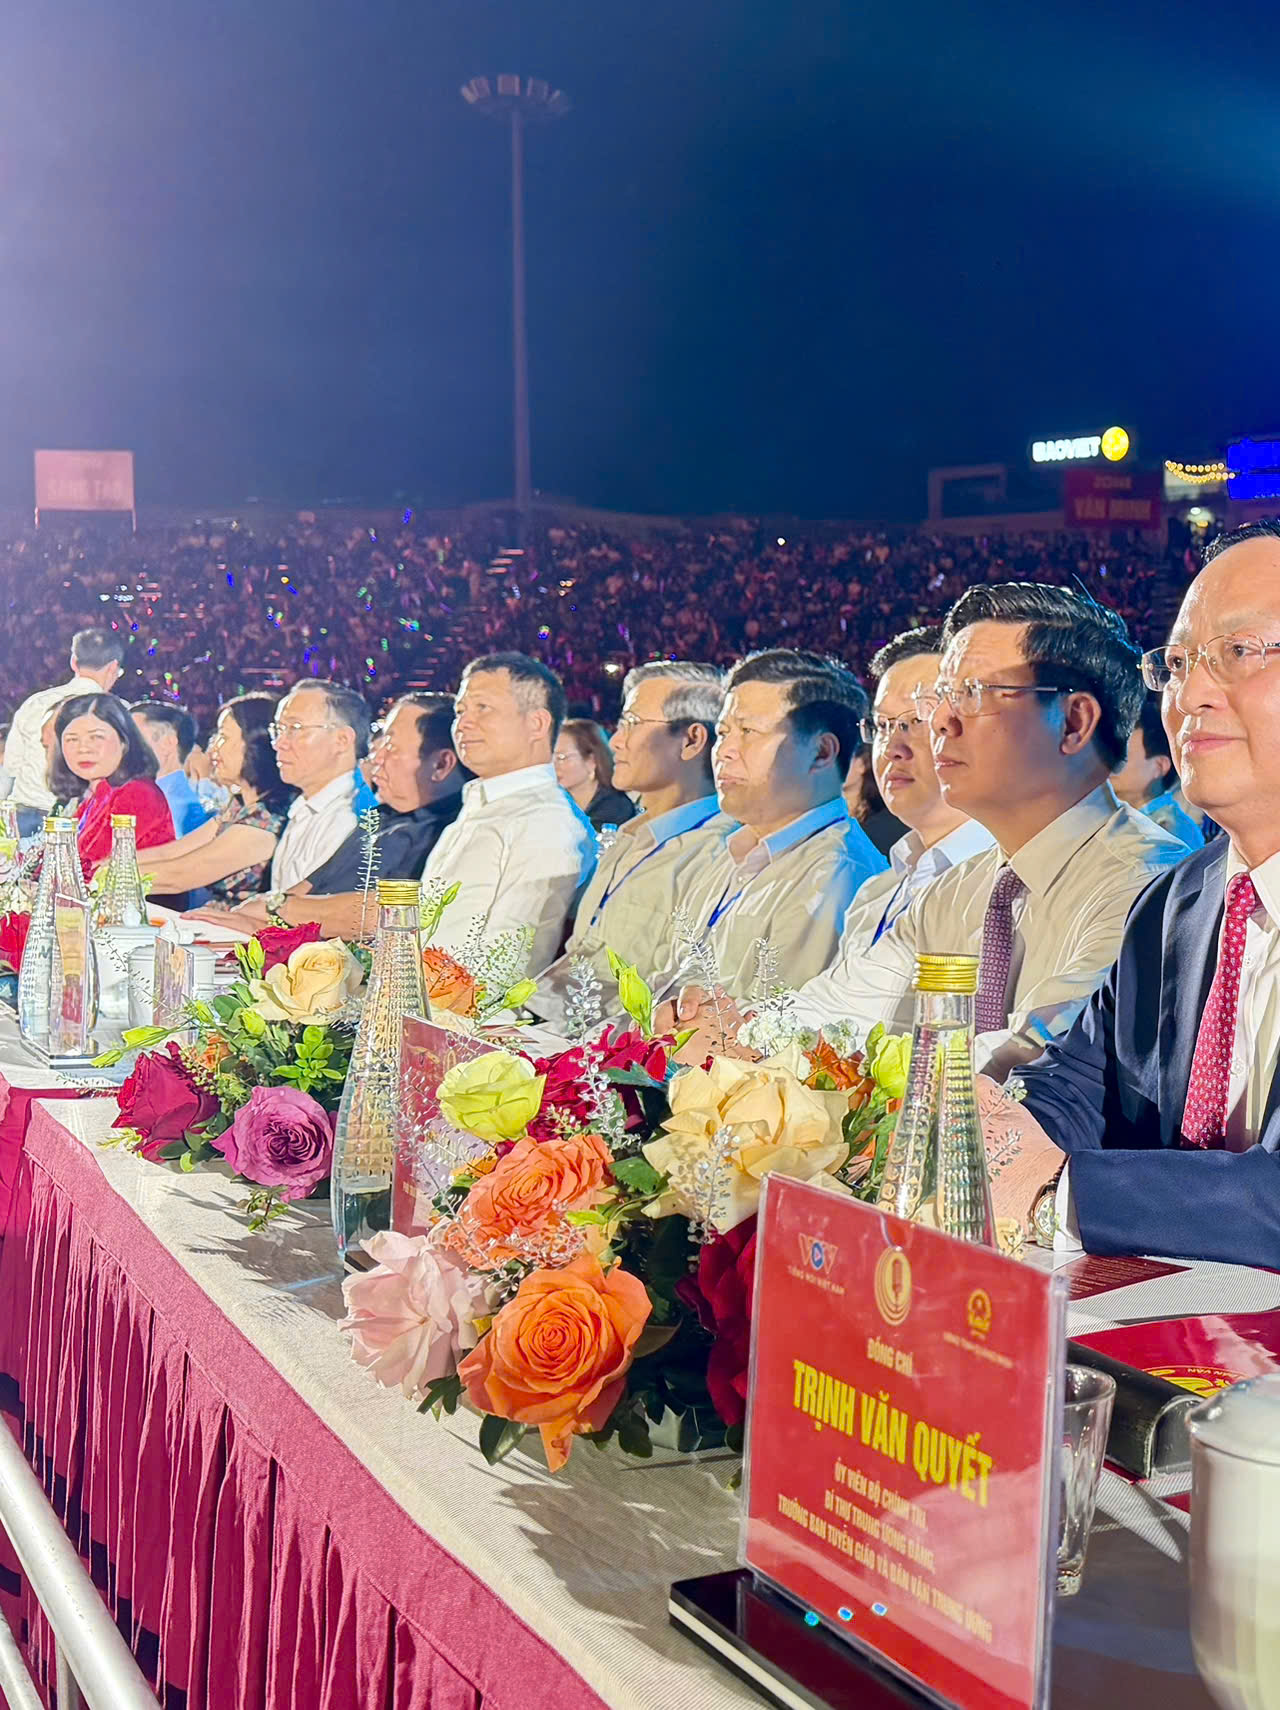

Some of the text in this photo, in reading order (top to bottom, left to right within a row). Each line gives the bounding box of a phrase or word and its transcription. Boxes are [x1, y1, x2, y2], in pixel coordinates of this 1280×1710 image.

[793, 1359, 993, 1508] TRỊNH VĂN QUYẾT
